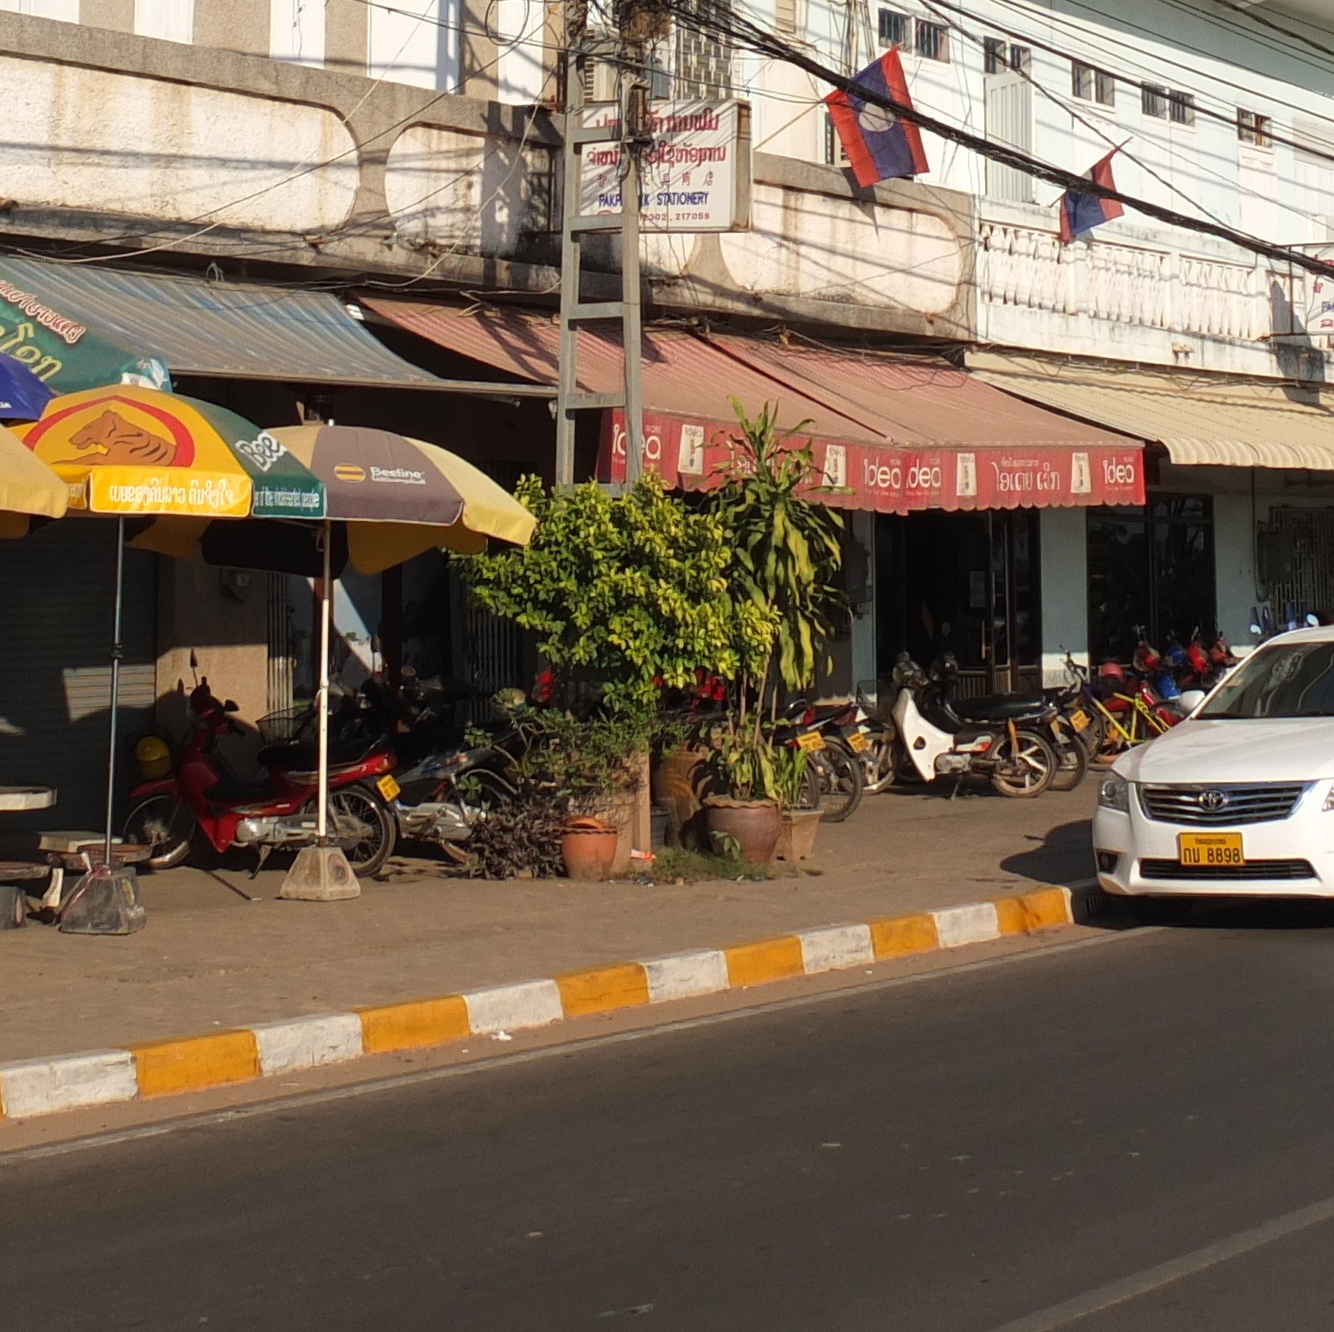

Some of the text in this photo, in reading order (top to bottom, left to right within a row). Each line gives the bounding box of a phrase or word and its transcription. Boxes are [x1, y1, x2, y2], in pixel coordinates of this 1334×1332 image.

[657, 191, 710, 207] STATIONERY
[863, 456, 901, 489] idea
[1102, 456, 1135, 485] idea
[1207, 847, 1241, 863] 8898
